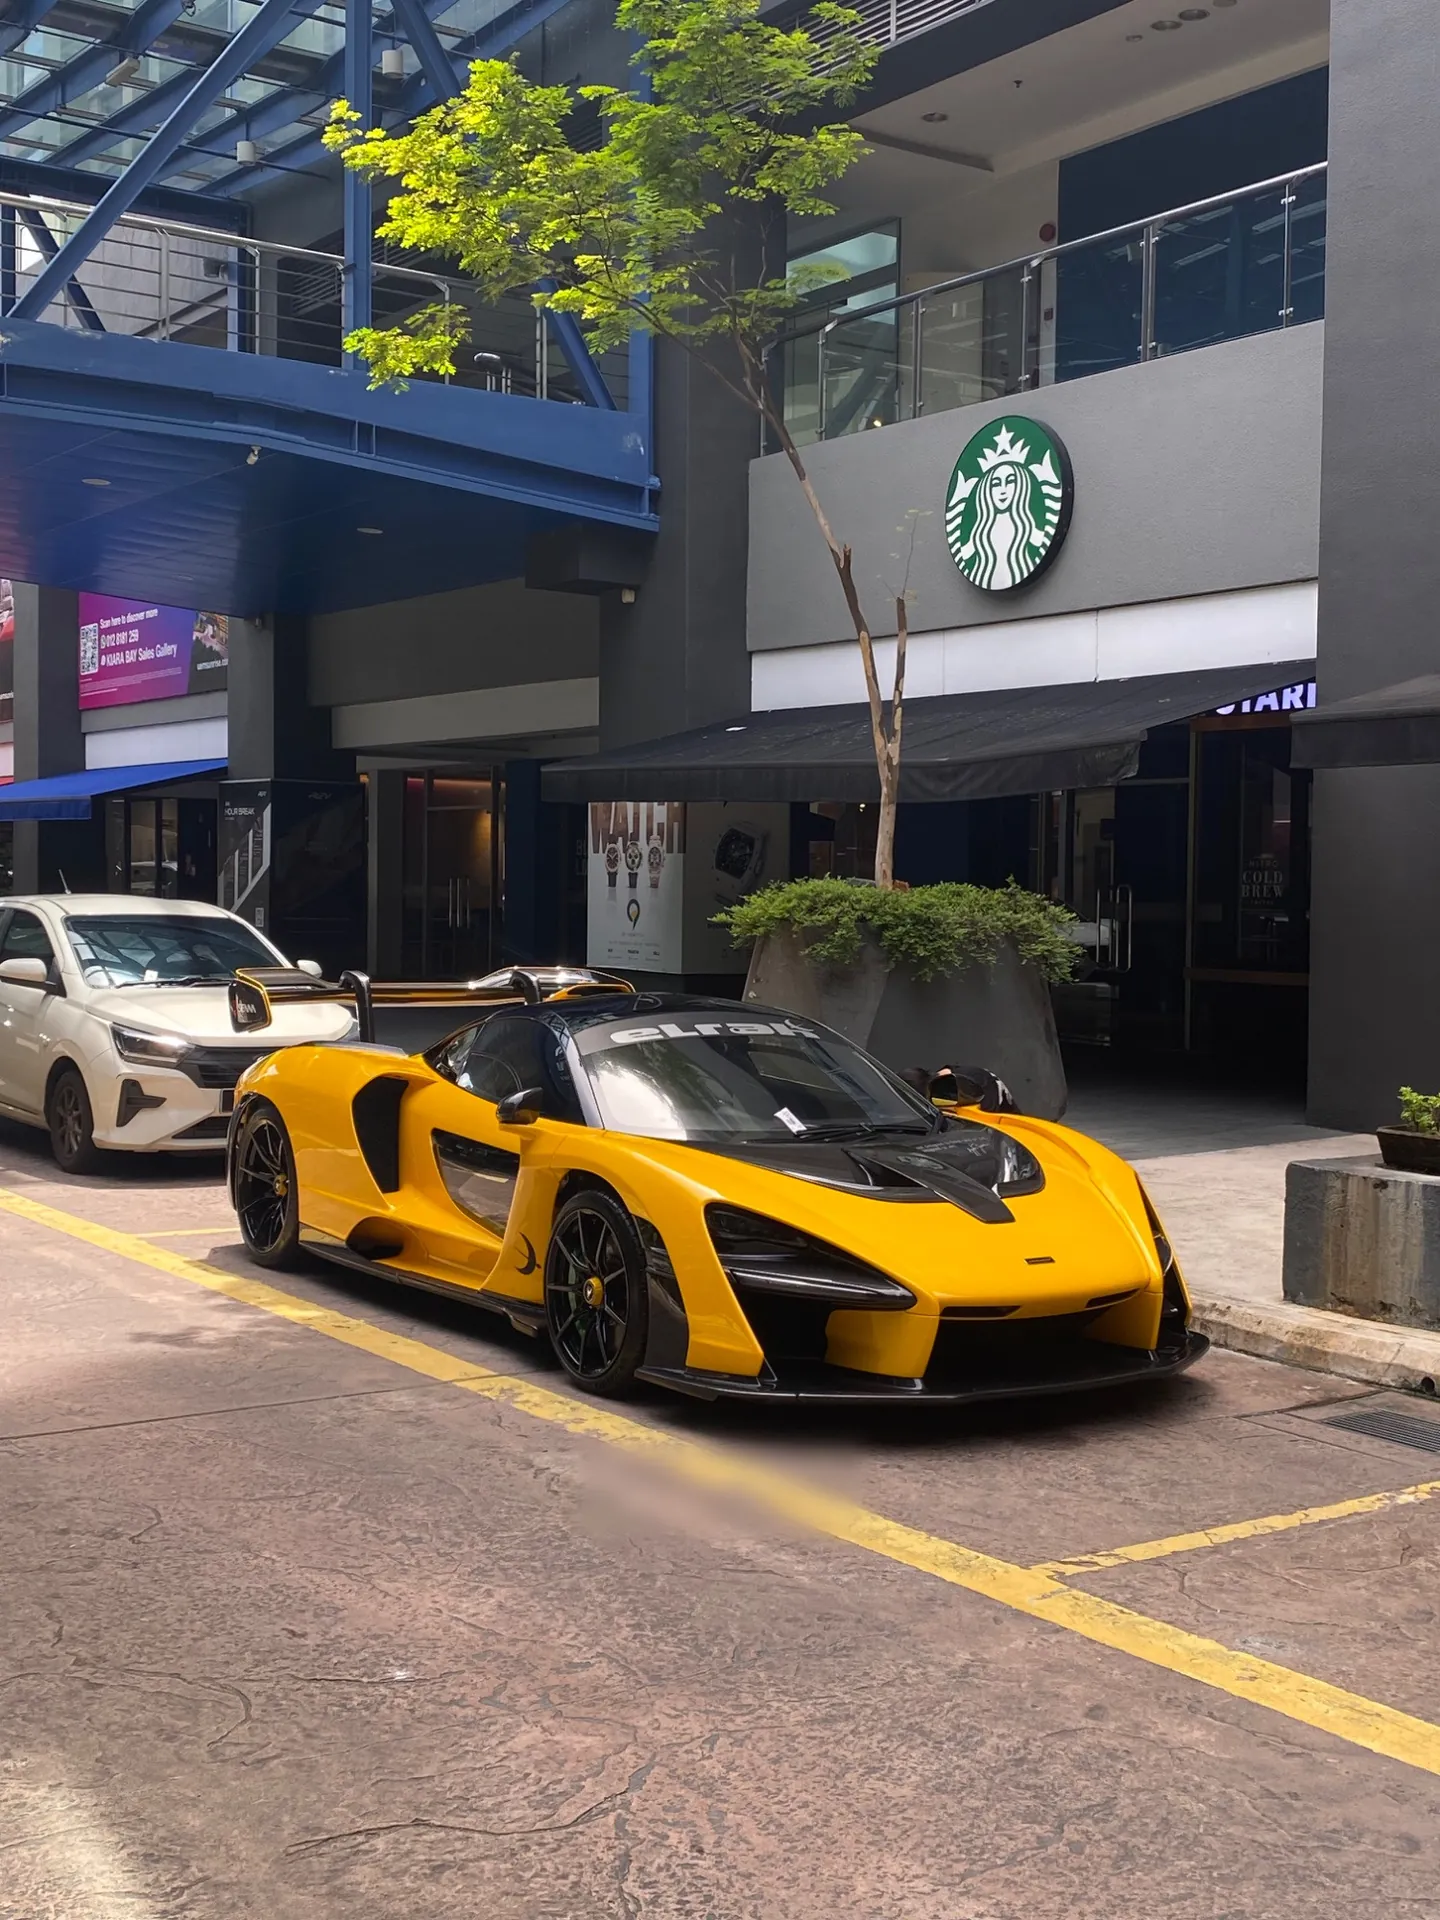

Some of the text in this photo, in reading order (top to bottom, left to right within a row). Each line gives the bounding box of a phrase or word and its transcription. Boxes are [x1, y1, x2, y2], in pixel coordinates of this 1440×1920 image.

[100, 608, 159, 629] Scan here to discover more
[106, 642, 178, 667] KIARA BAY Sales Gallery
[1242, 870, 1283, 884] COLD
[1241, 884, 1285, 898] BREW
